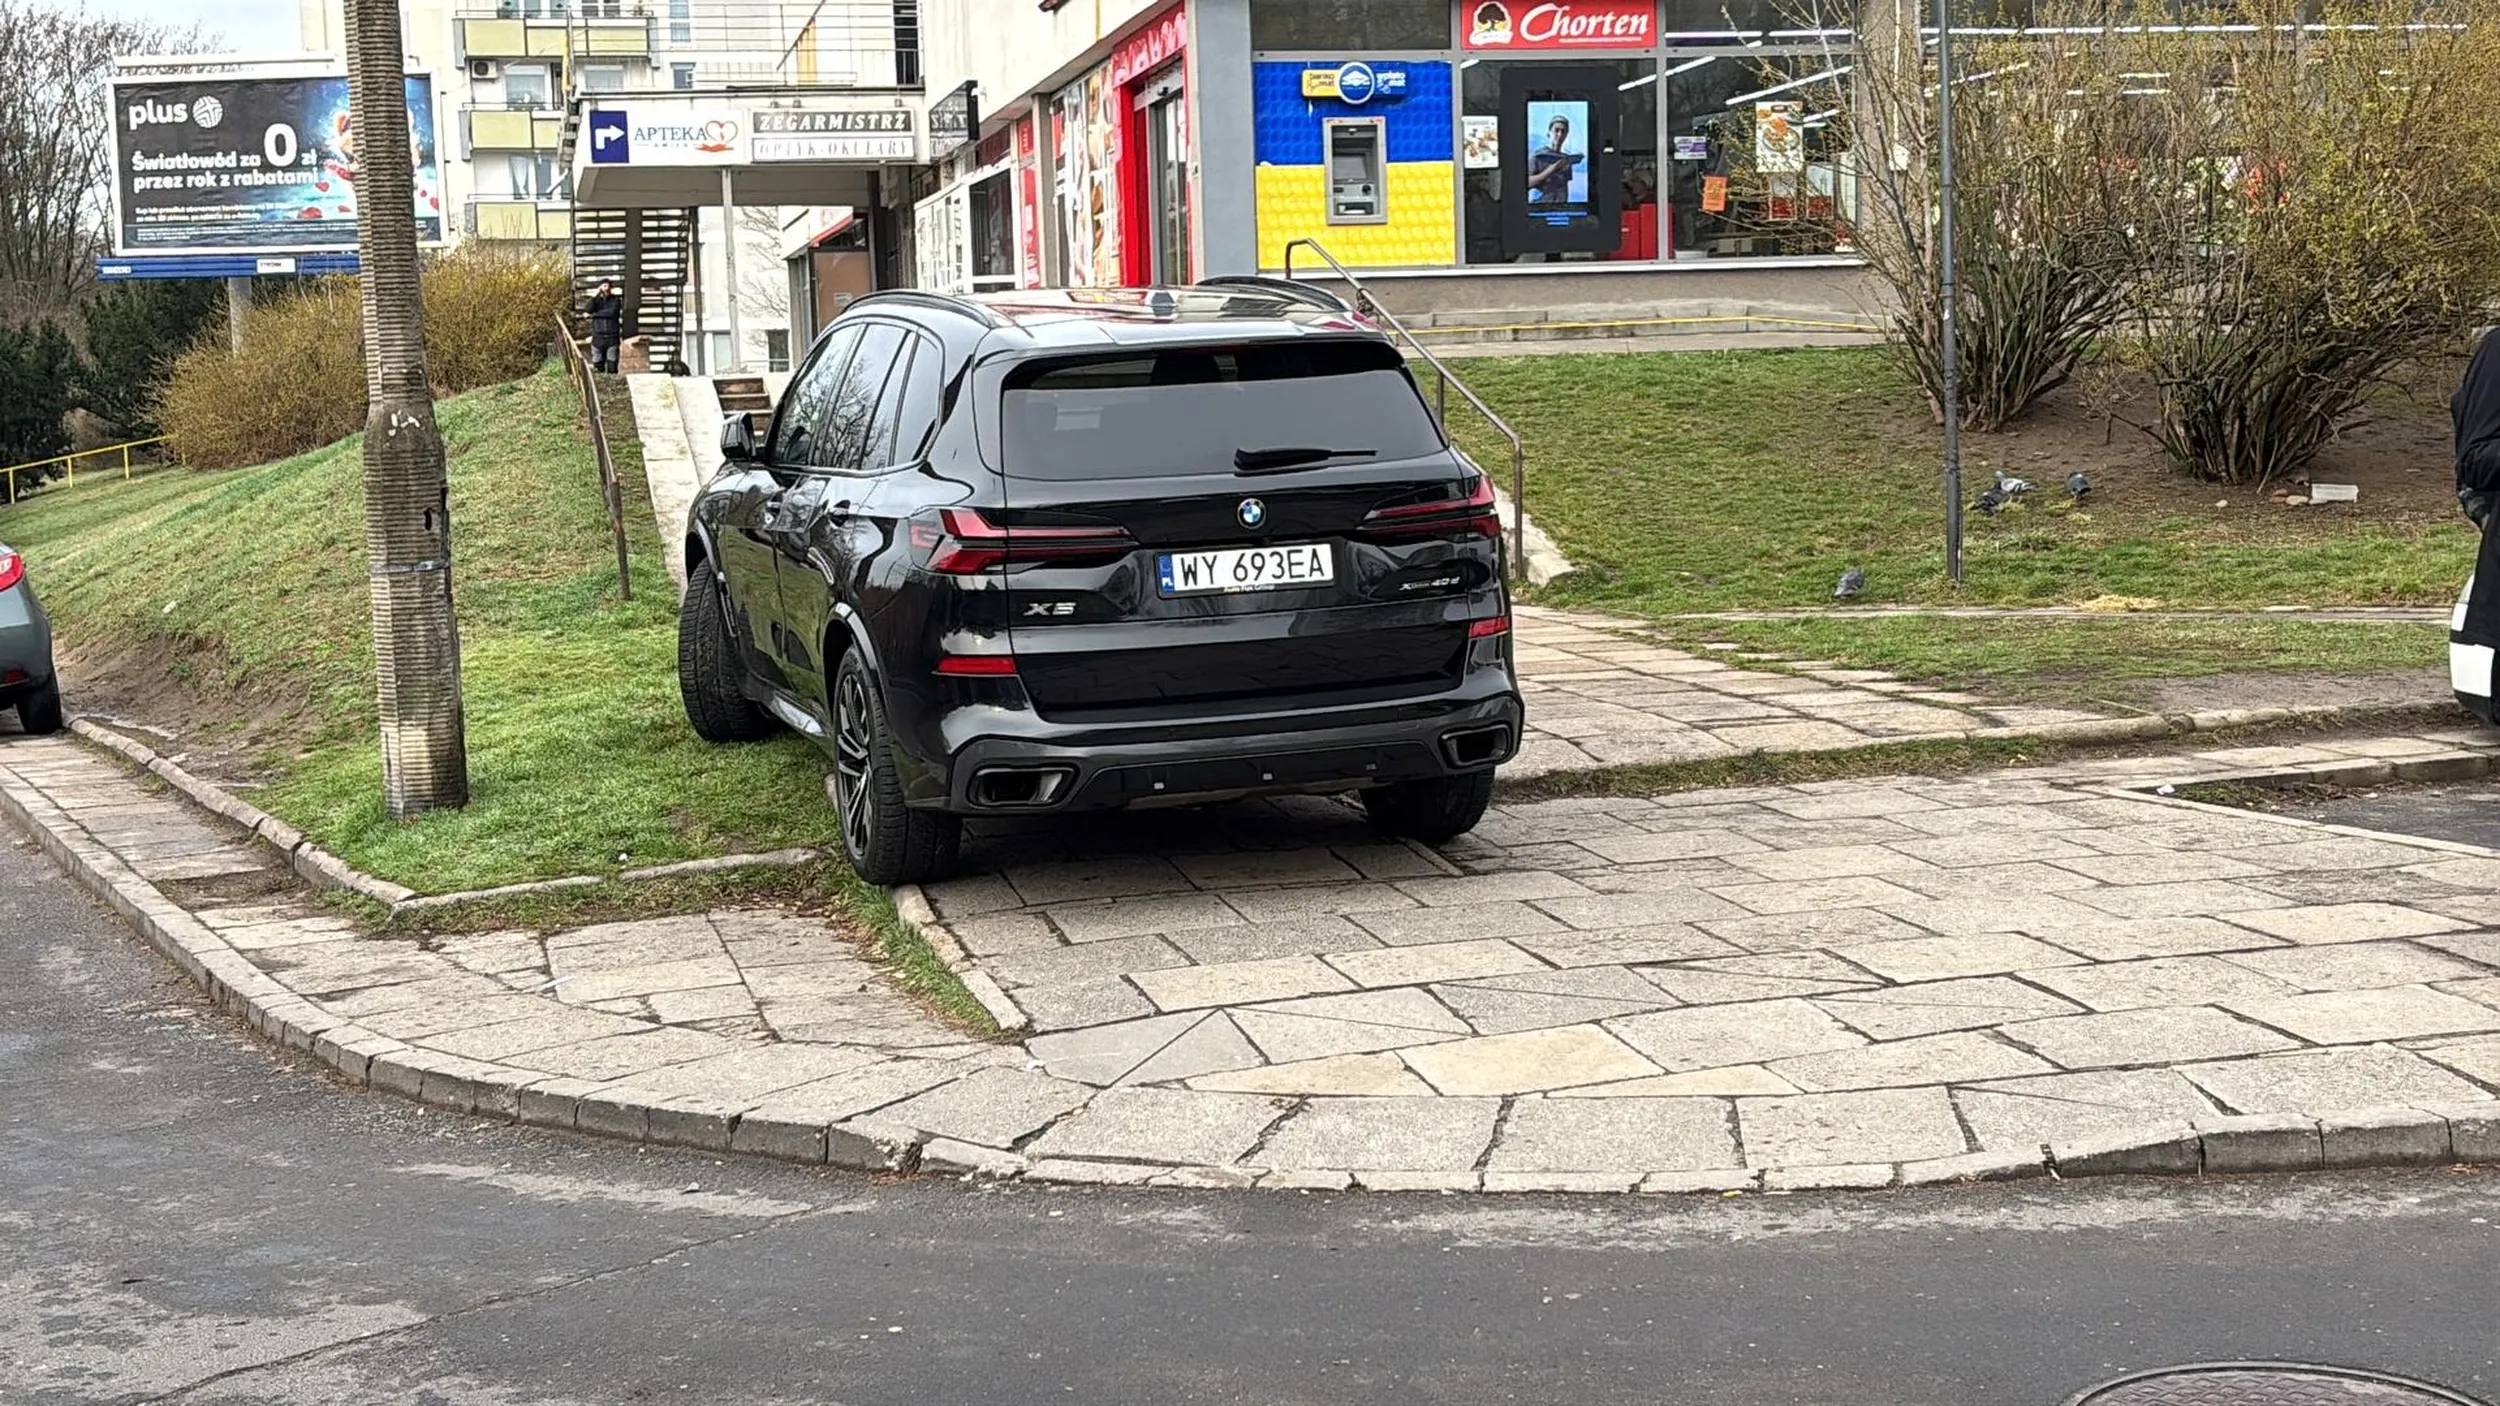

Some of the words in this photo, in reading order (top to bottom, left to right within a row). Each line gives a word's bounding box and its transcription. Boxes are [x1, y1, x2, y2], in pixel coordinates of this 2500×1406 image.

[1519, 3, 1648, 42] Chorten
[128, 99, 188, 130] plus
[759, 112, 906, 131] ZEGARMISTRZ
[131, 151, 237, 171] Światłowód
[239, 155, 261, 168] za
[263, 123, 298, 167] 0
[301, 149, 318, 165] zł
[633, 127, 708, 142] APTEKA
[133, 176, 184, 194] przez
[186, 170, 217, 188] rok
[219, 175, 231, 187] z
[233, 168, 319, 186] rabatami
[1180, 555, 1218, 587] WY
[1232, 548, 1325, 588] 693EA
[1023, 602, 1077, 616] X5
